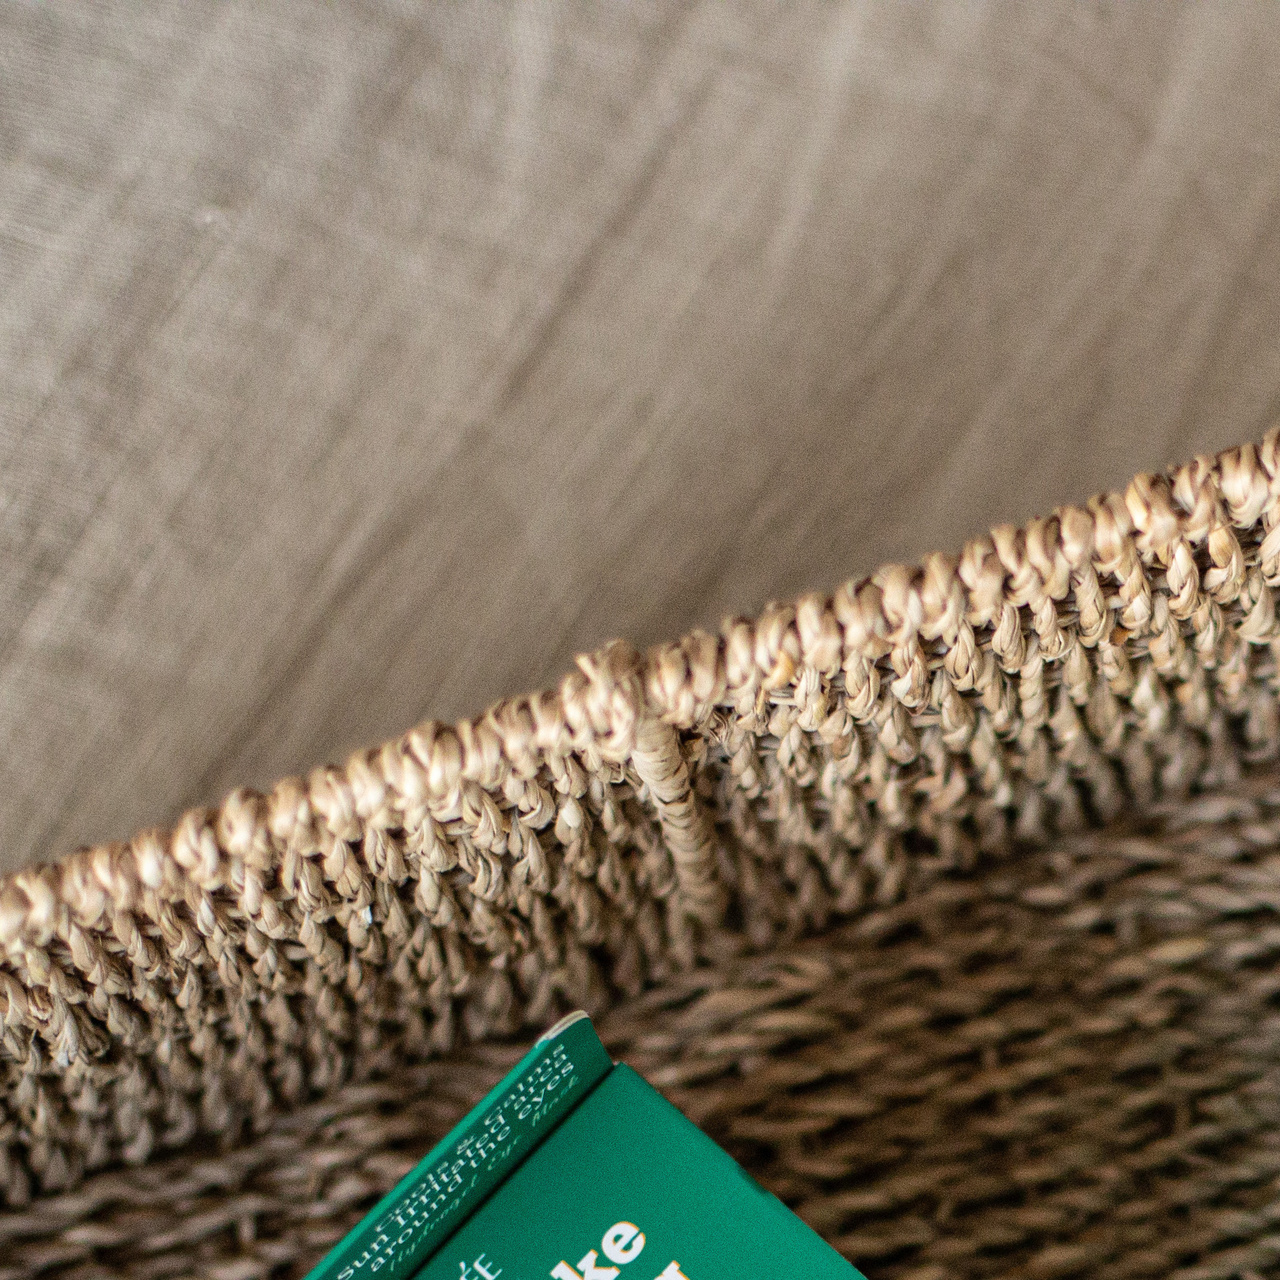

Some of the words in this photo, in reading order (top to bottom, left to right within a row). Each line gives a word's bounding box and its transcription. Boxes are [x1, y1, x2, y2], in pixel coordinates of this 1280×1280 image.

[370, 1173, 463, 1273] around
[469, 1126, 512, 1169] the
[518, 1062, 575, 1120] eyes
[395, 1114, 506, 1229] Irritated
[513, 1053, 568, 1111] area
